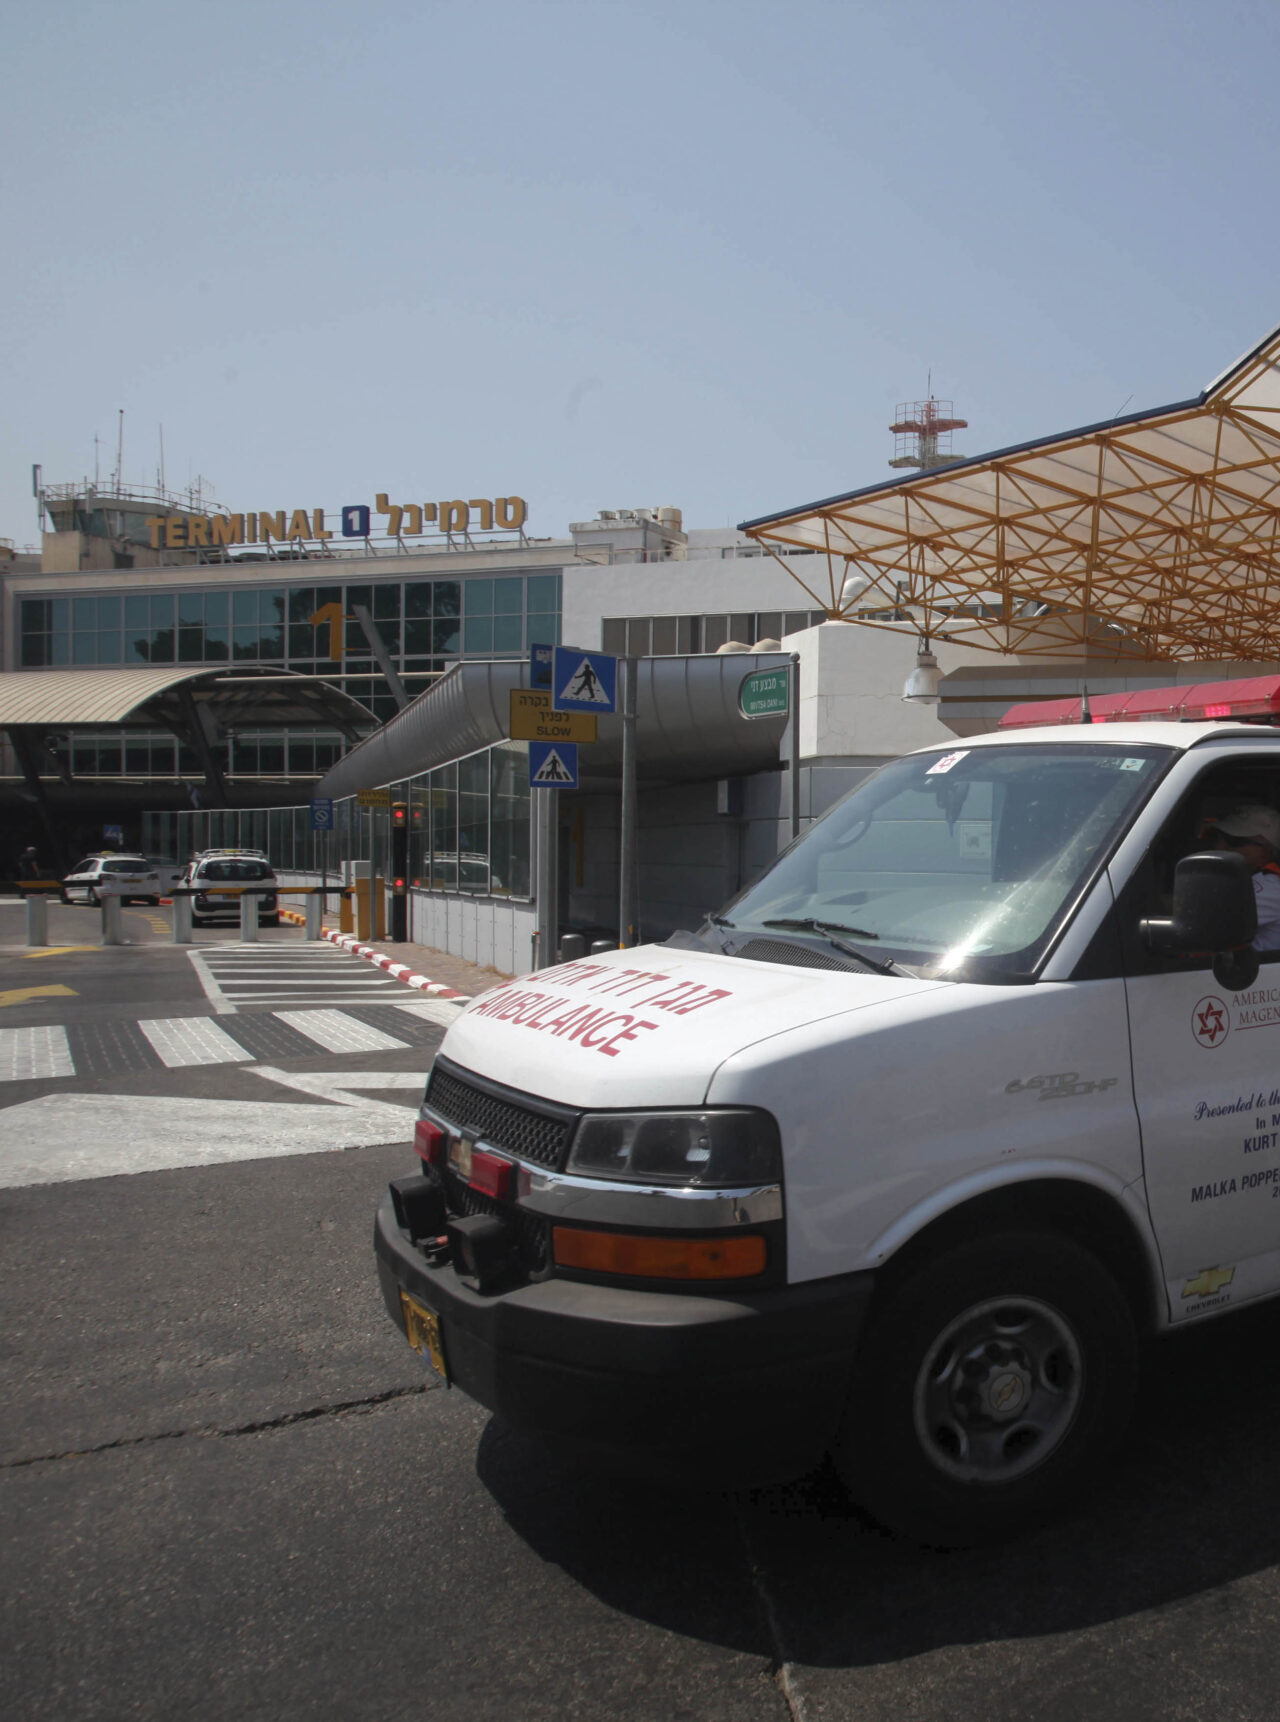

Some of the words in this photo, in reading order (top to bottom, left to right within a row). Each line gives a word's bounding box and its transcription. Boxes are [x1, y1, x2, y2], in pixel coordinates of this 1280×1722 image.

[145, 509, 332, 548] TERMINAL
[376, 493, 527, 536] טרמינל
[537, 726, 571, 737] SLOW
[588, 969, 672, 997] דוד
[630, 981, 733, 1015] מגן
[467, 989, 660, 1057] AMBULANCE
[1239, 1006, 1280, 1025] MAGEN
[1194, 1092, 1254, 1120] Presented
[1256, 1092, 1267, 1108] to
[1256, 1117, 1266, 1130] In
[1244, 1133, 1278, 1153] KURT
[1191, 1179, 1237, 1203] MALKA
